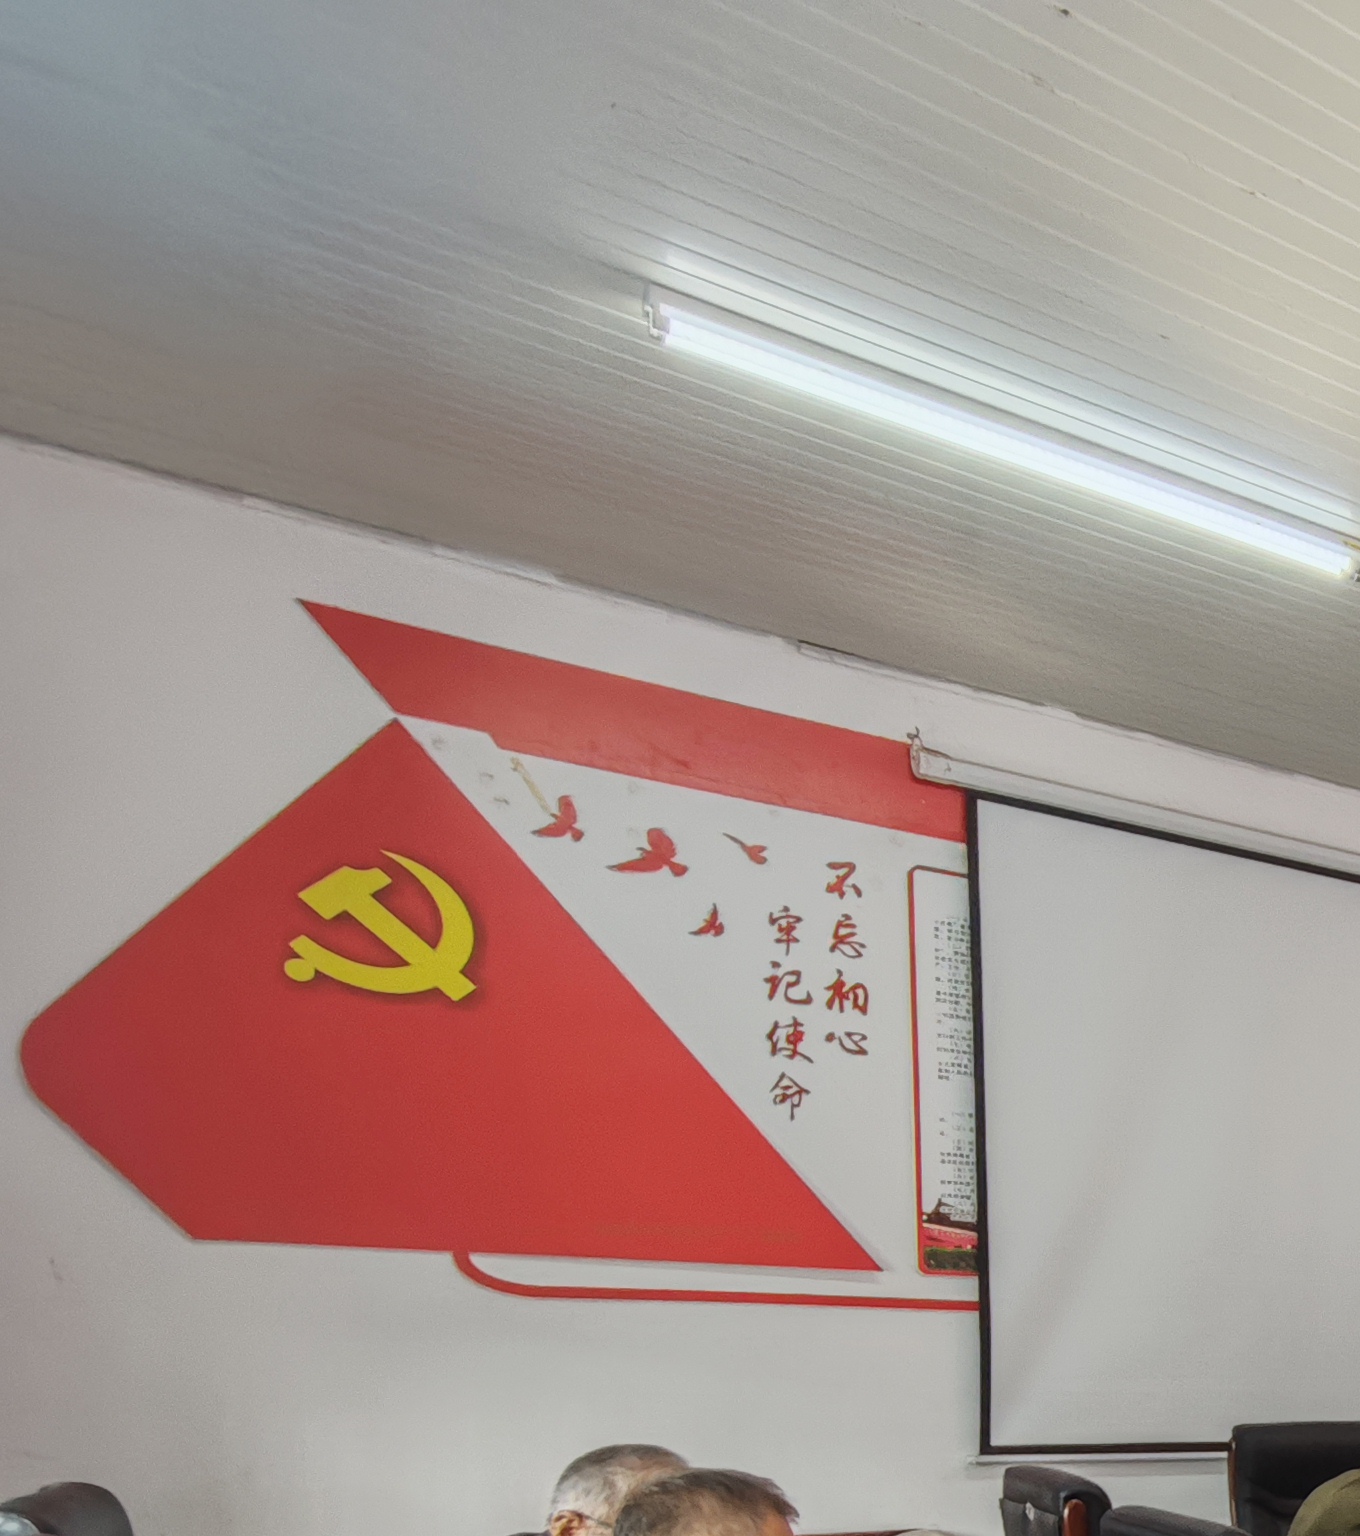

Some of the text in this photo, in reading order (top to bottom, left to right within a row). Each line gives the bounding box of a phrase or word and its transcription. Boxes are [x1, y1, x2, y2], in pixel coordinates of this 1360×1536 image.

[763, 905, 815, 1121] 牢记使命
[823, 861, 870, 1058] 不忘初心
